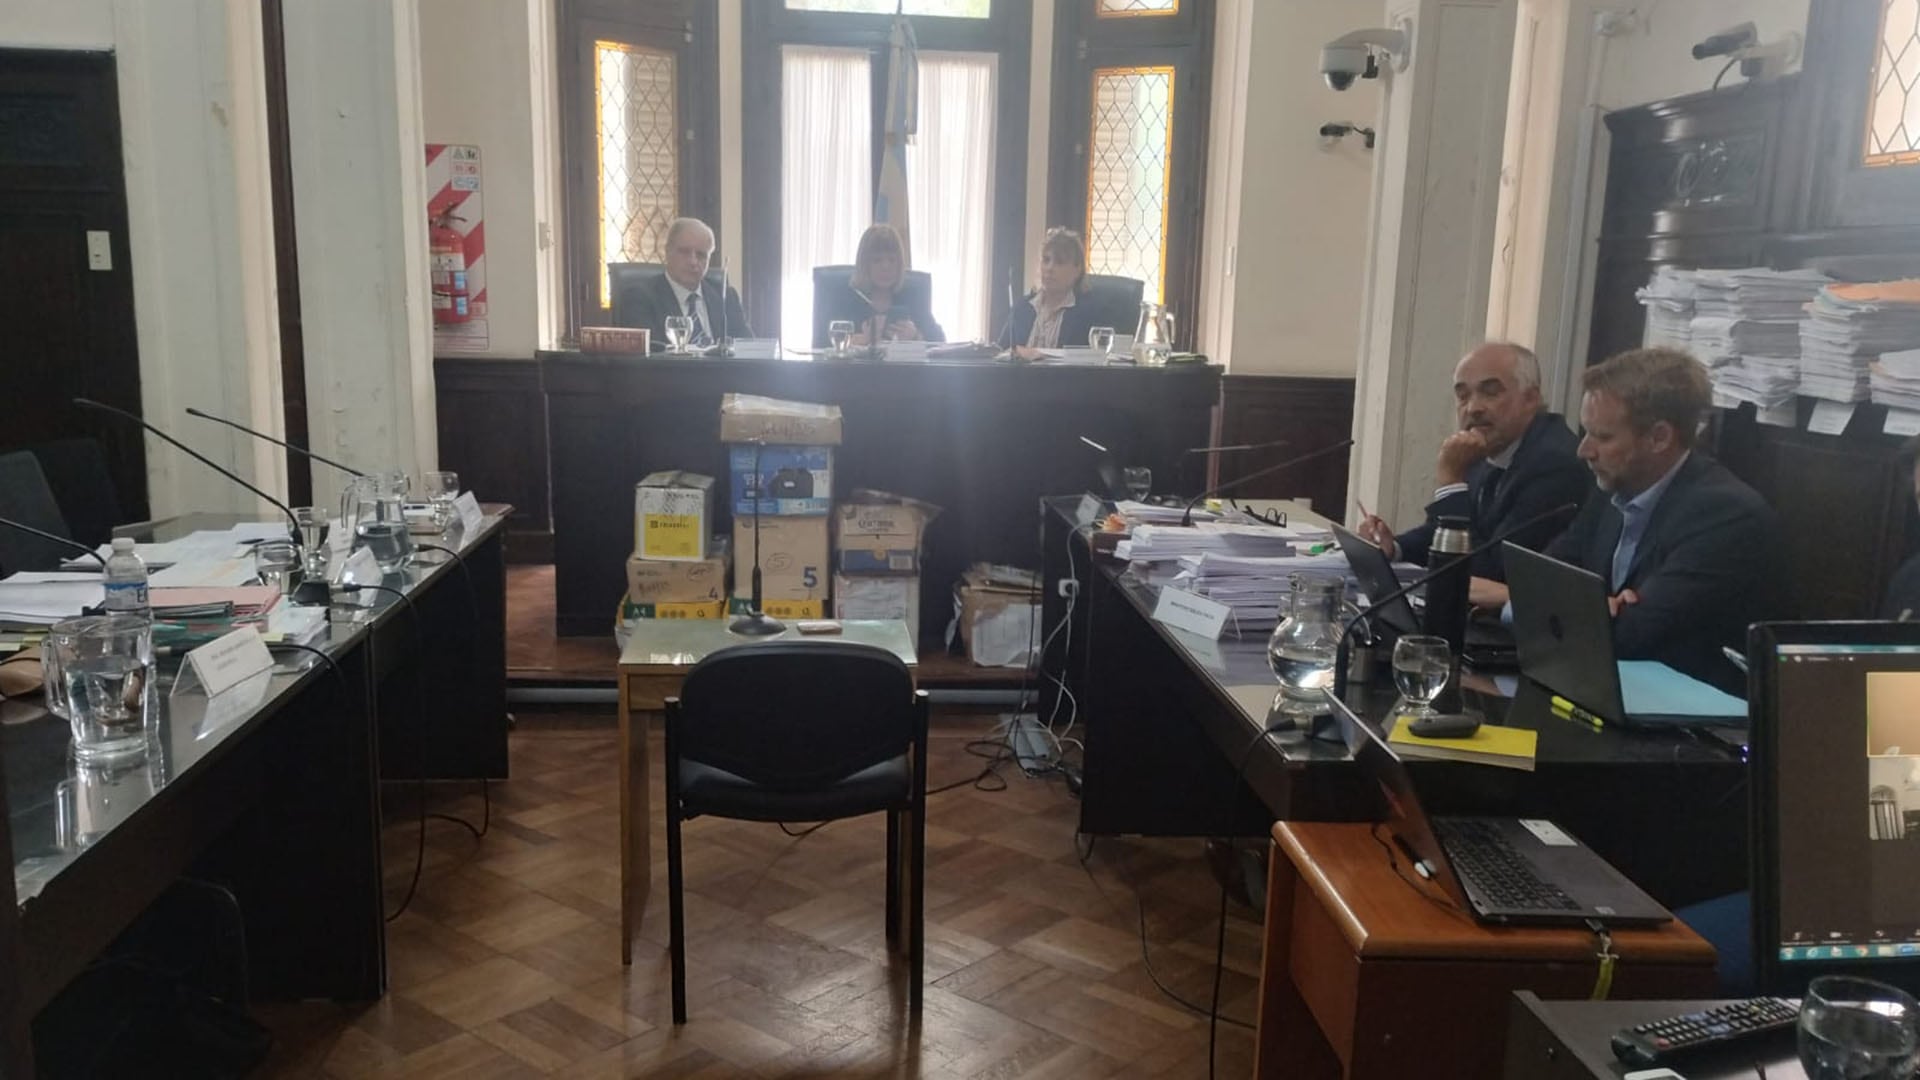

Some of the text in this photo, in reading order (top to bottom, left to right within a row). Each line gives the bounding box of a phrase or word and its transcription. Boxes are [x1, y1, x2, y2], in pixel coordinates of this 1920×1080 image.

[803, 566, 818, 588] 5
[708, 586, 718, 600] 4
[632, 607, 646, 616] A4
